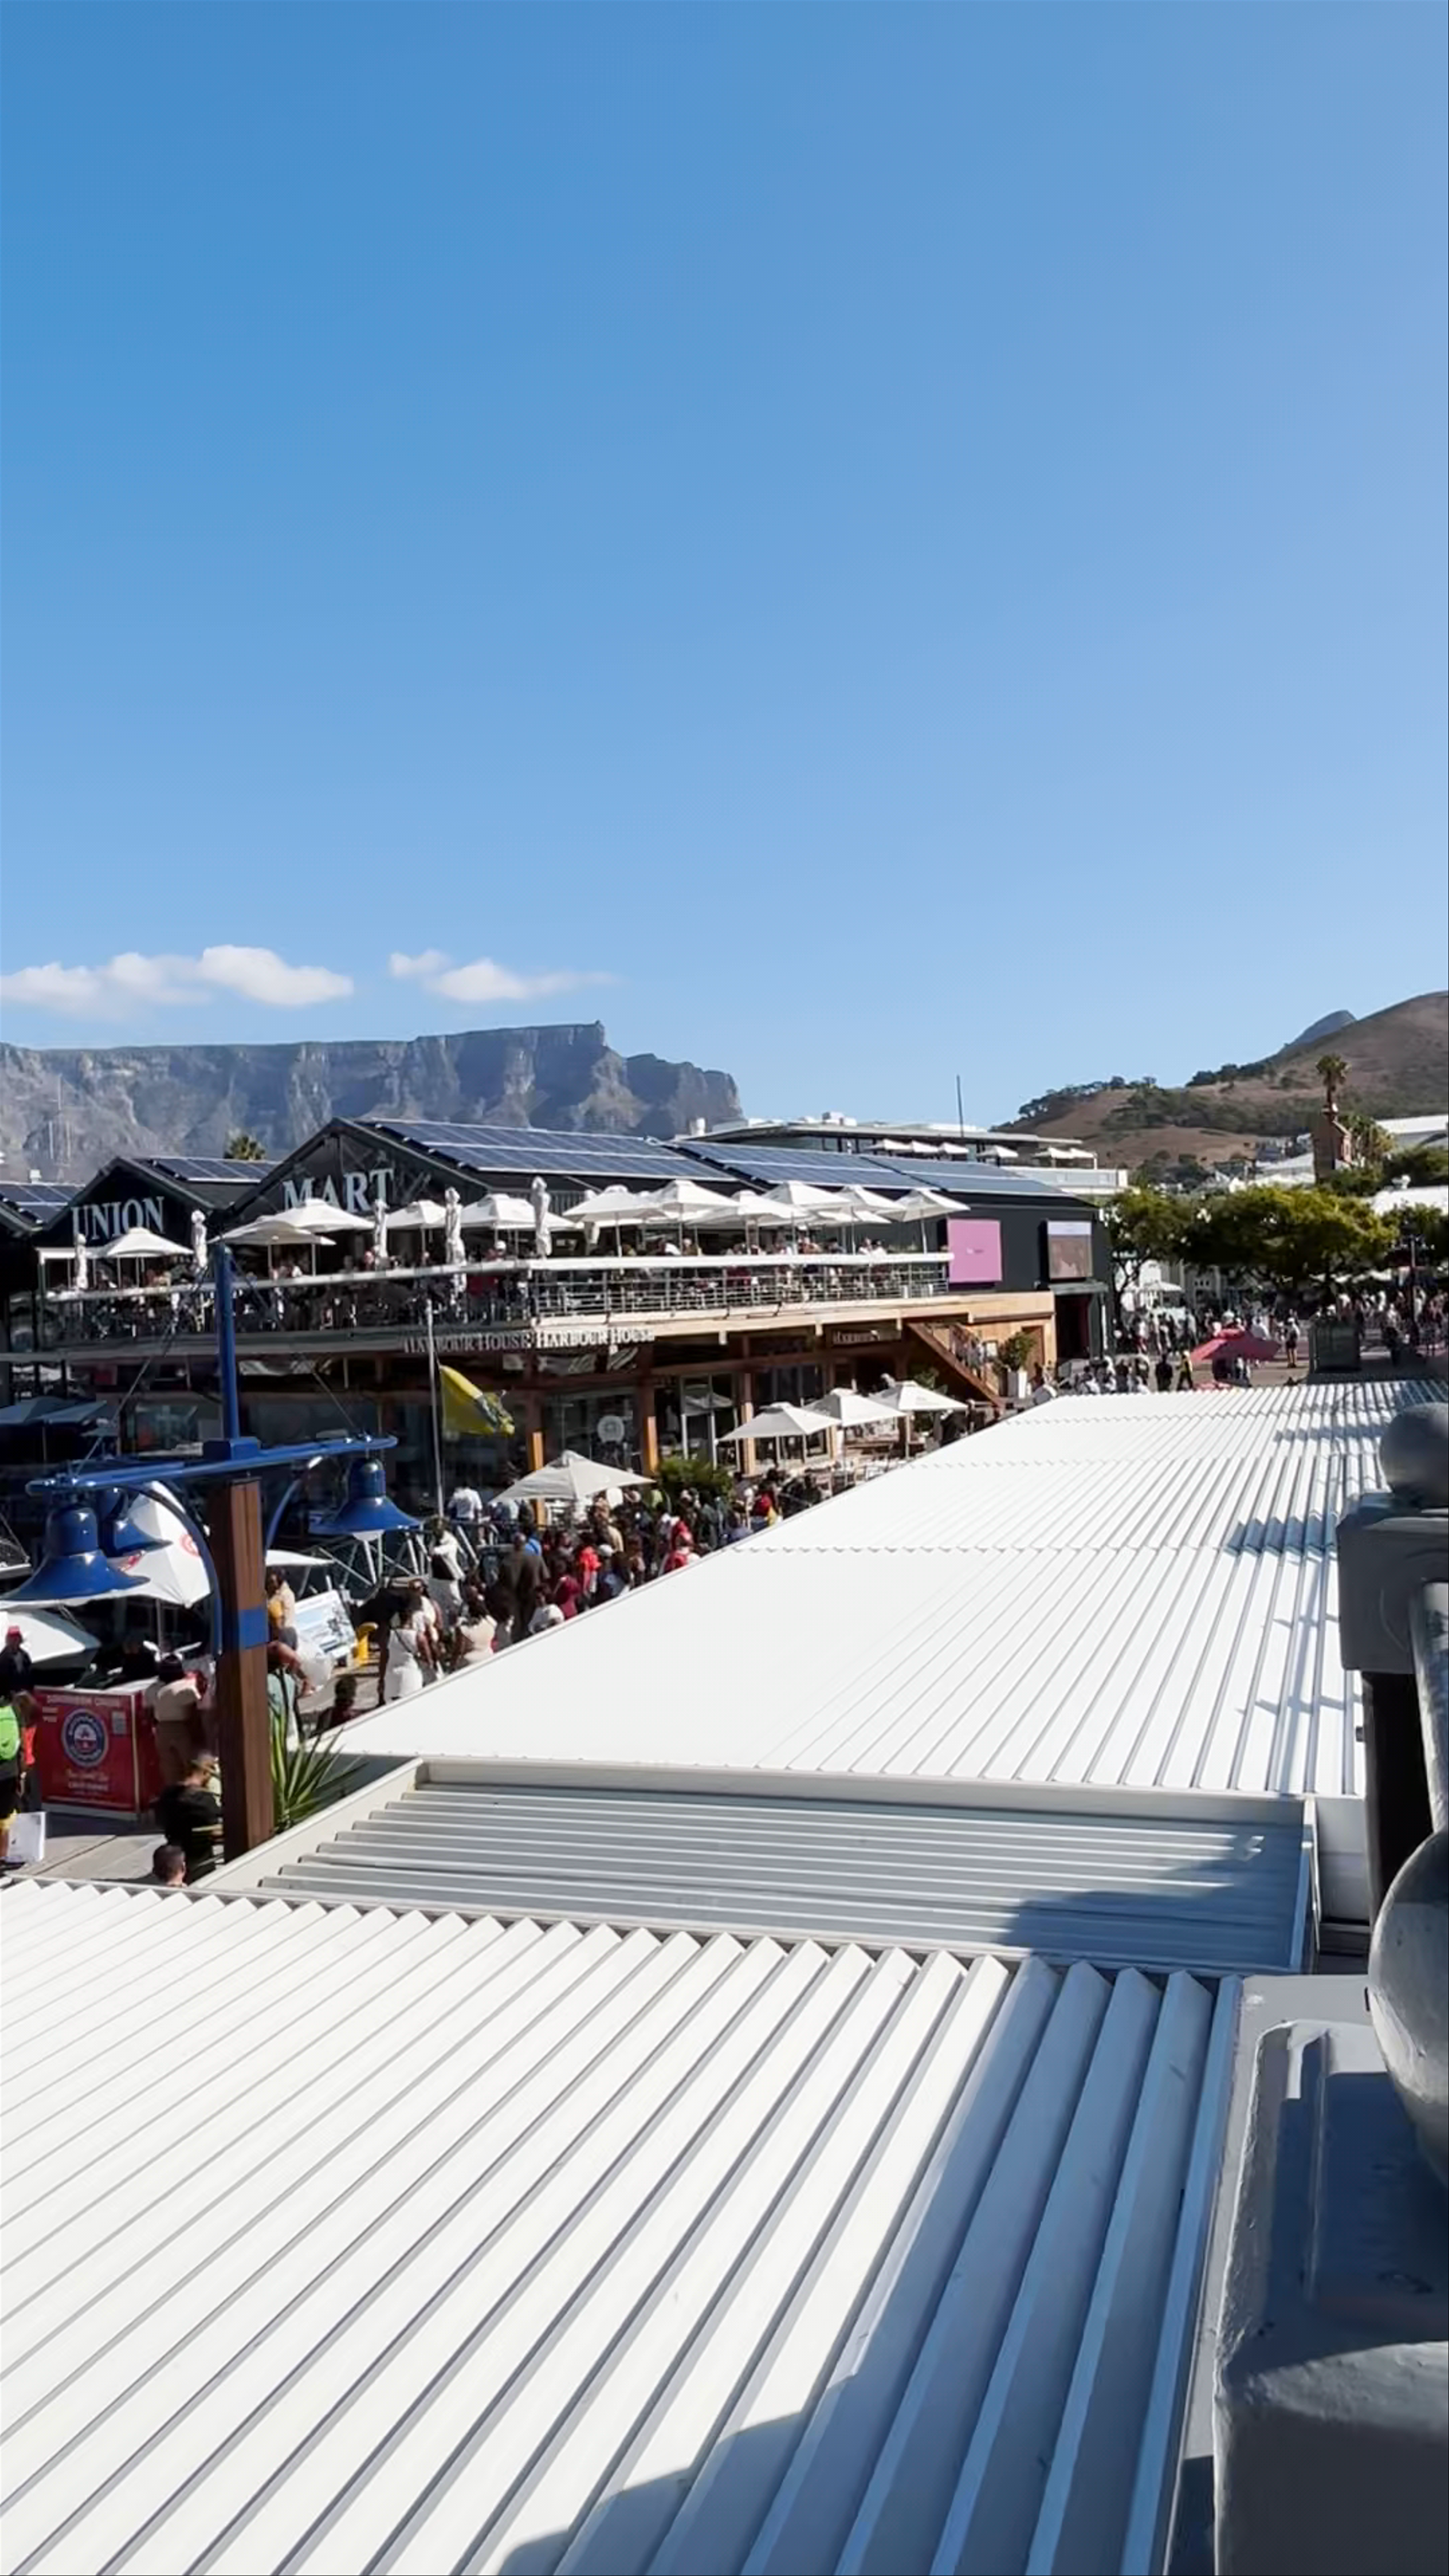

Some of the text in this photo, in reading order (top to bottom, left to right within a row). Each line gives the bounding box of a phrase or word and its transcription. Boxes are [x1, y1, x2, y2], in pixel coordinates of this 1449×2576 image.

[283, 1168, 394, 1213] MART
[71, 1196, 165, 1240] UNION
[478, 1331, 530, 1351] HOUSE
[536, 1326, 655, 1348] HARBOUR HOUSE
